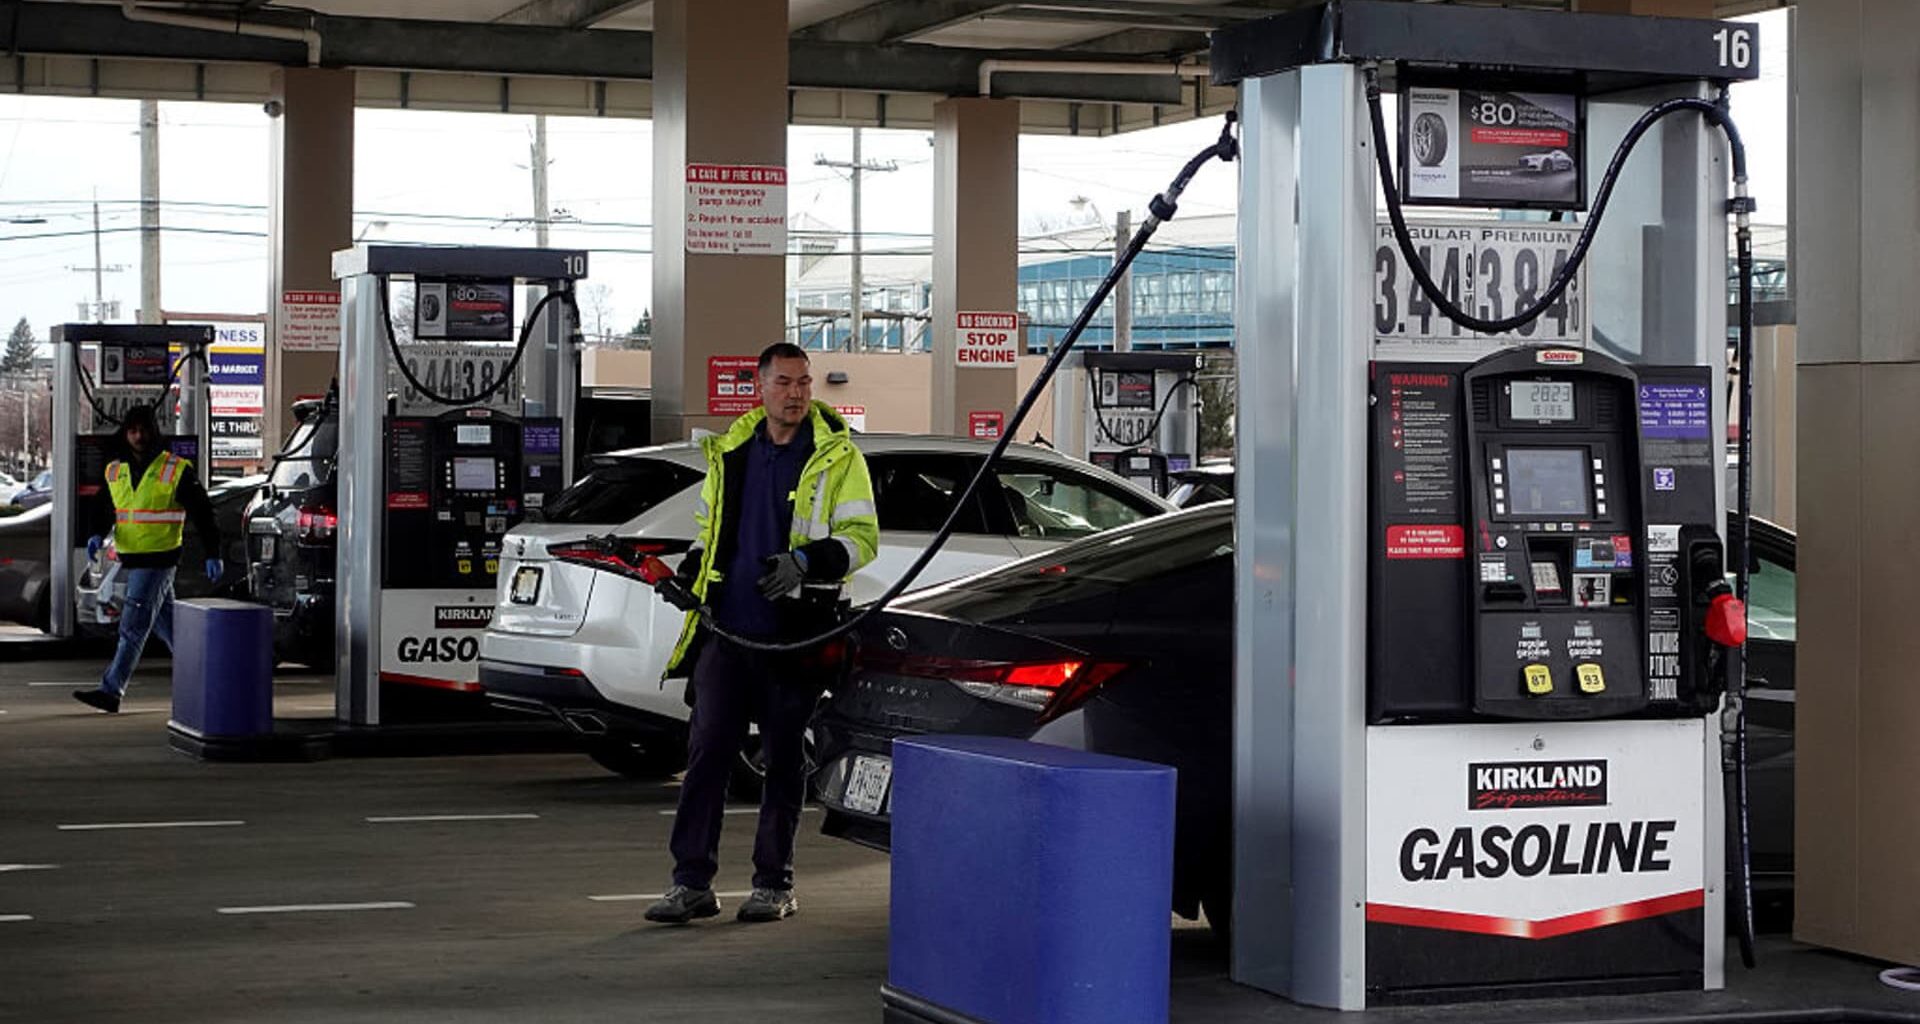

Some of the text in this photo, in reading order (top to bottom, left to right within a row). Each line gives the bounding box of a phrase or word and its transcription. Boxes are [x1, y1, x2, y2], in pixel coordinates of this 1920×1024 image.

[1713, 29, 1750, 69] 16
[1471, 102, 1516, 125] $80
[699, 169, 718, 180] CASE
[699, 186, 715, 195] Use
[719, 188, 766, 197] emergency
[699, 213, 727, 224] Report
[747, 216, 784, 225] accident
[1381, 228, 1572, 243] RGULAR PREMIUM
[564, 256, 585, 275] 10
[1376, 245, 1461, 336] 3.44
[961, 315, 1013, 328] NO SMOKING
[967, 332, 1008, 346] STOP
[958, 349, 1016, 363] ENGINE
[1195, 355, 1203, 369] 6
[221, 365, 258, 374] MARKET
[1391, 374, 1449, 387] WARNING
[228, 421, 258, 433] THRU
[438, 607, 495, 621] KIRKLAN
[398, 636, 480, 663] GASO
[1531, 674, 1600, 686] 87 93
[1476, 764, 1602, 790] KIRKLAND
[1399, 820, 1677, 882] GASOLINE
